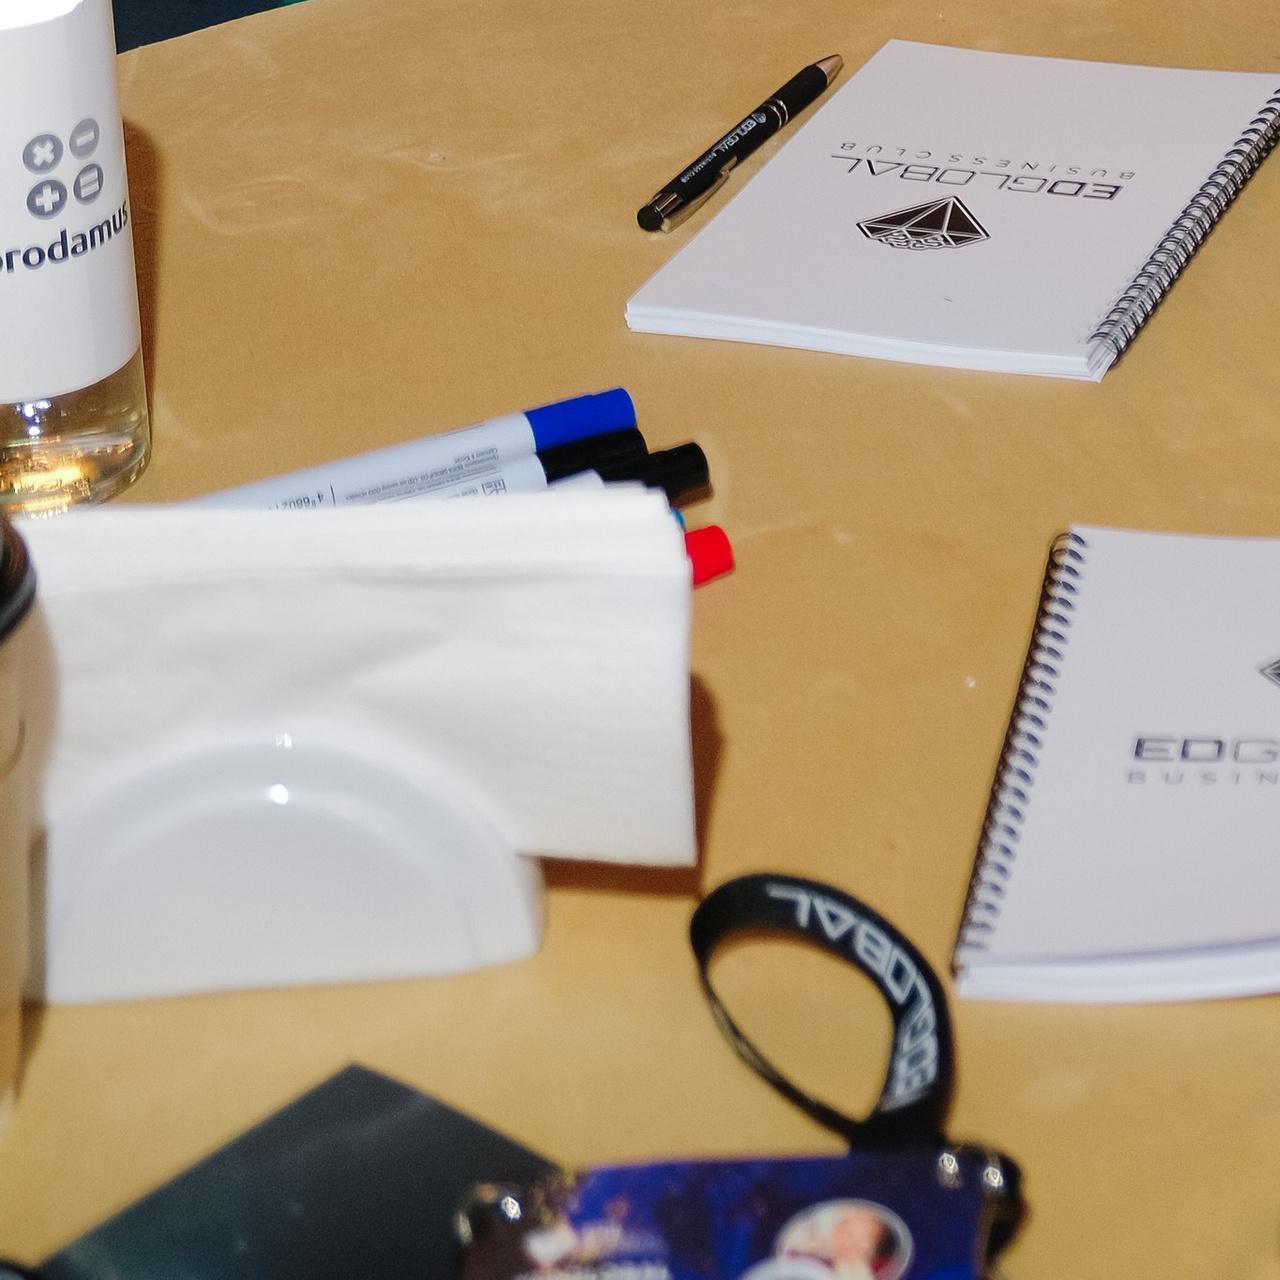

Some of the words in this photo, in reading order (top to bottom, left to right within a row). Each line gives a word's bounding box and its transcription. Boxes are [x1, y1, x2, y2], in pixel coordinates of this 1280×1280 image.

[839, 141, 932, 161] CLUB
[831, 154, 1124, 201] EDGLOBAL
[948, 153, 1136, 181] BUSINESS
